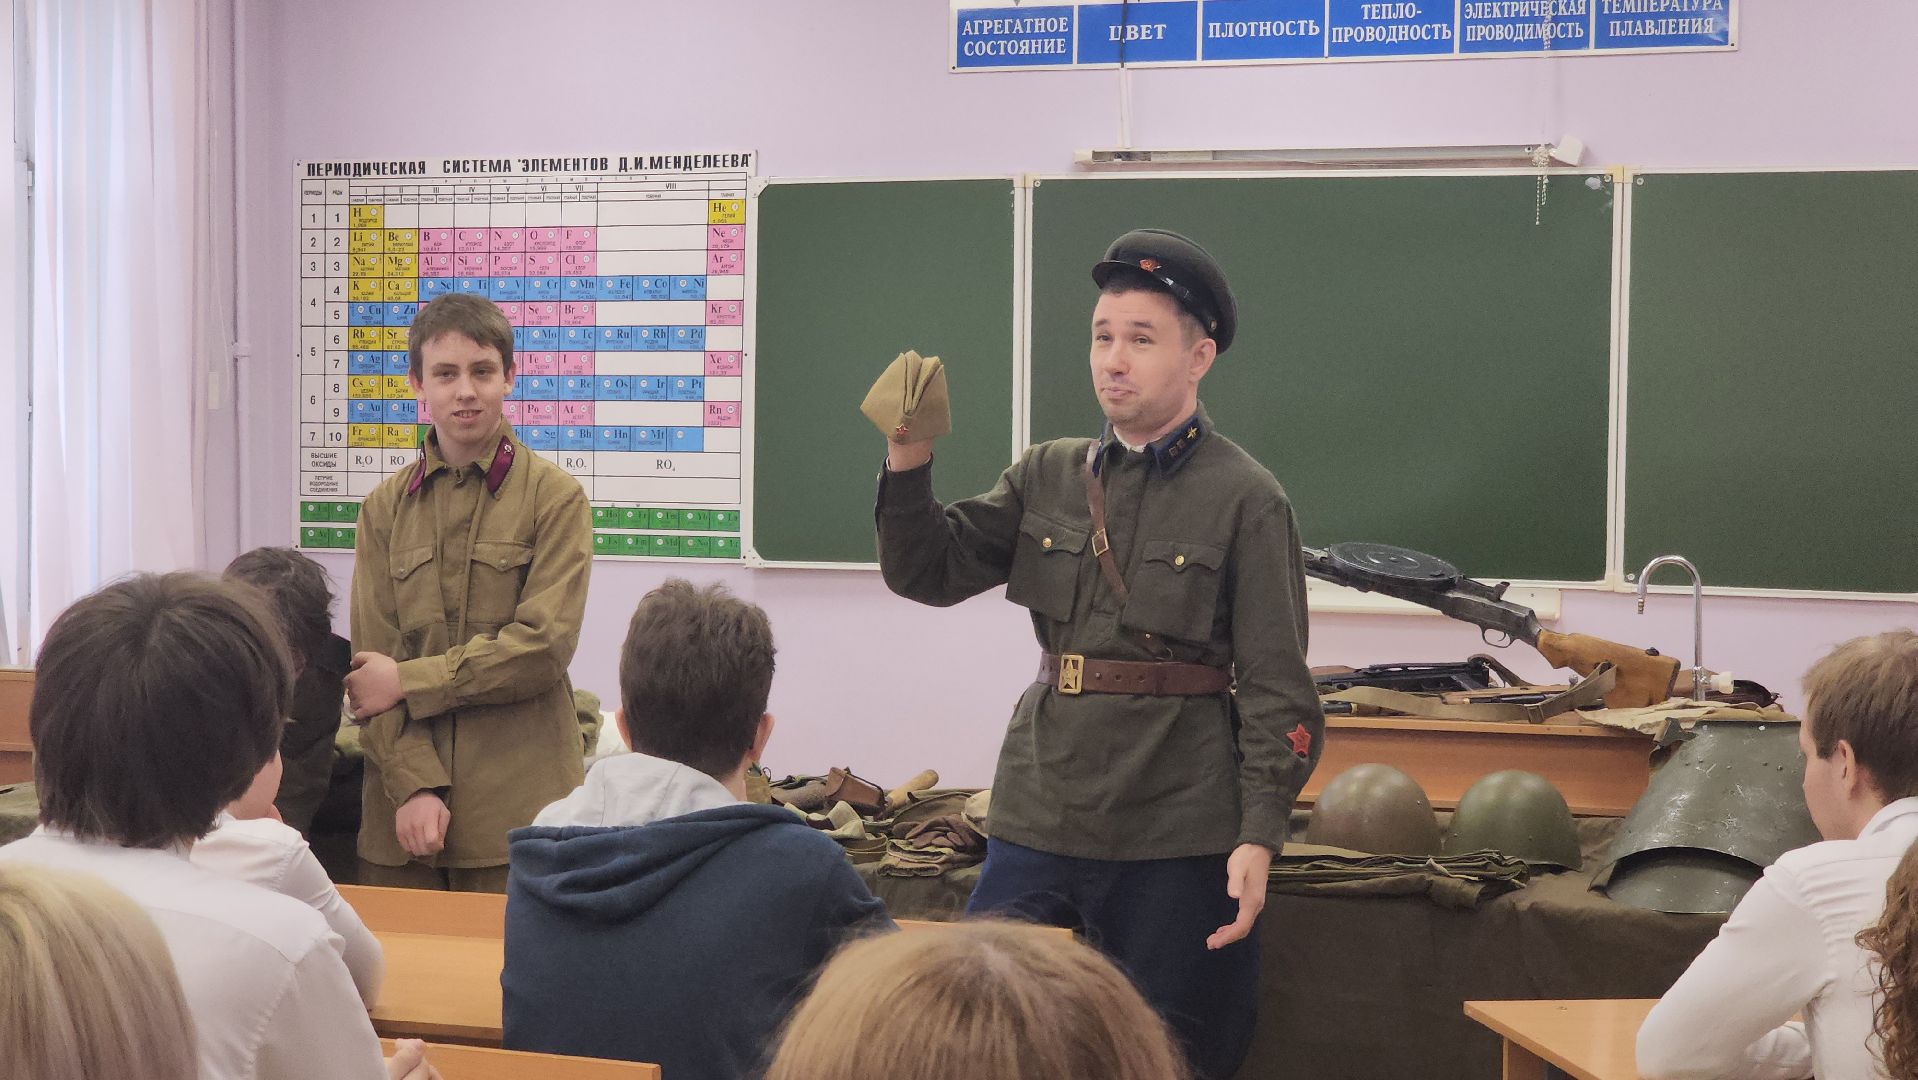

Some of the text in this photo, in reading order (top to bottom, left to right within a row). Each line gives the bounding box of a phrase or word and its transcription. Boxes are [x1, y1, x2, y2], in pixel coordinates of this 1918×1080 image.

[1362, 2, 1422, 19] ТЕПЛО-
[962, 17, 1069, 36] АГРЕГАТНОЕ
[1208, 20, 1320, 39] ПЛОТНОСТЬ
[1609, 18, 1714, 36] ПЛАВЛЕНИЯ
[1109, 24, 1167, 43] ЦВЕТ
[1332, 22, 1452, 44] ПРОВОДНОСТЬ
[1466, 22, 1584, 42] ПРОВОДИМОСТЬ
[963, 38, 1067, 57] СОСТОЯНИЕ
[307, 160, 426, 177] ПЕРИОДИЧЕСКАЯ
[443, 159, 512, 174] СИСТЕМА
[522, 157, 608, 173] ЭЛЕМЕНТОВ
[311, 213, 316, 223] 1
[335, 213, 340, 223] 1
[310, 237, 317, 247] 2
[334, 237, 341, 247] 2
[310, 261, 317, 272] 3
[333, 261, 340, 272] 3
[333, 286, 340, 295] 4
[310, 298, 317, 307] 4
[333, 310, 340, 320] 5
[333, 335, 340, 344] 6
[310, 347, 317, 356] 5
[333, 359, 340, 369] 7
[333, 384, 340, 393] 8
[310, 395, 316, 405] 6
[333, 407, 340, 417] 9
[310, 432, 316, 441] 7
[329, 432, 342, 441] 10
[390, 455, 405, 465] RO
